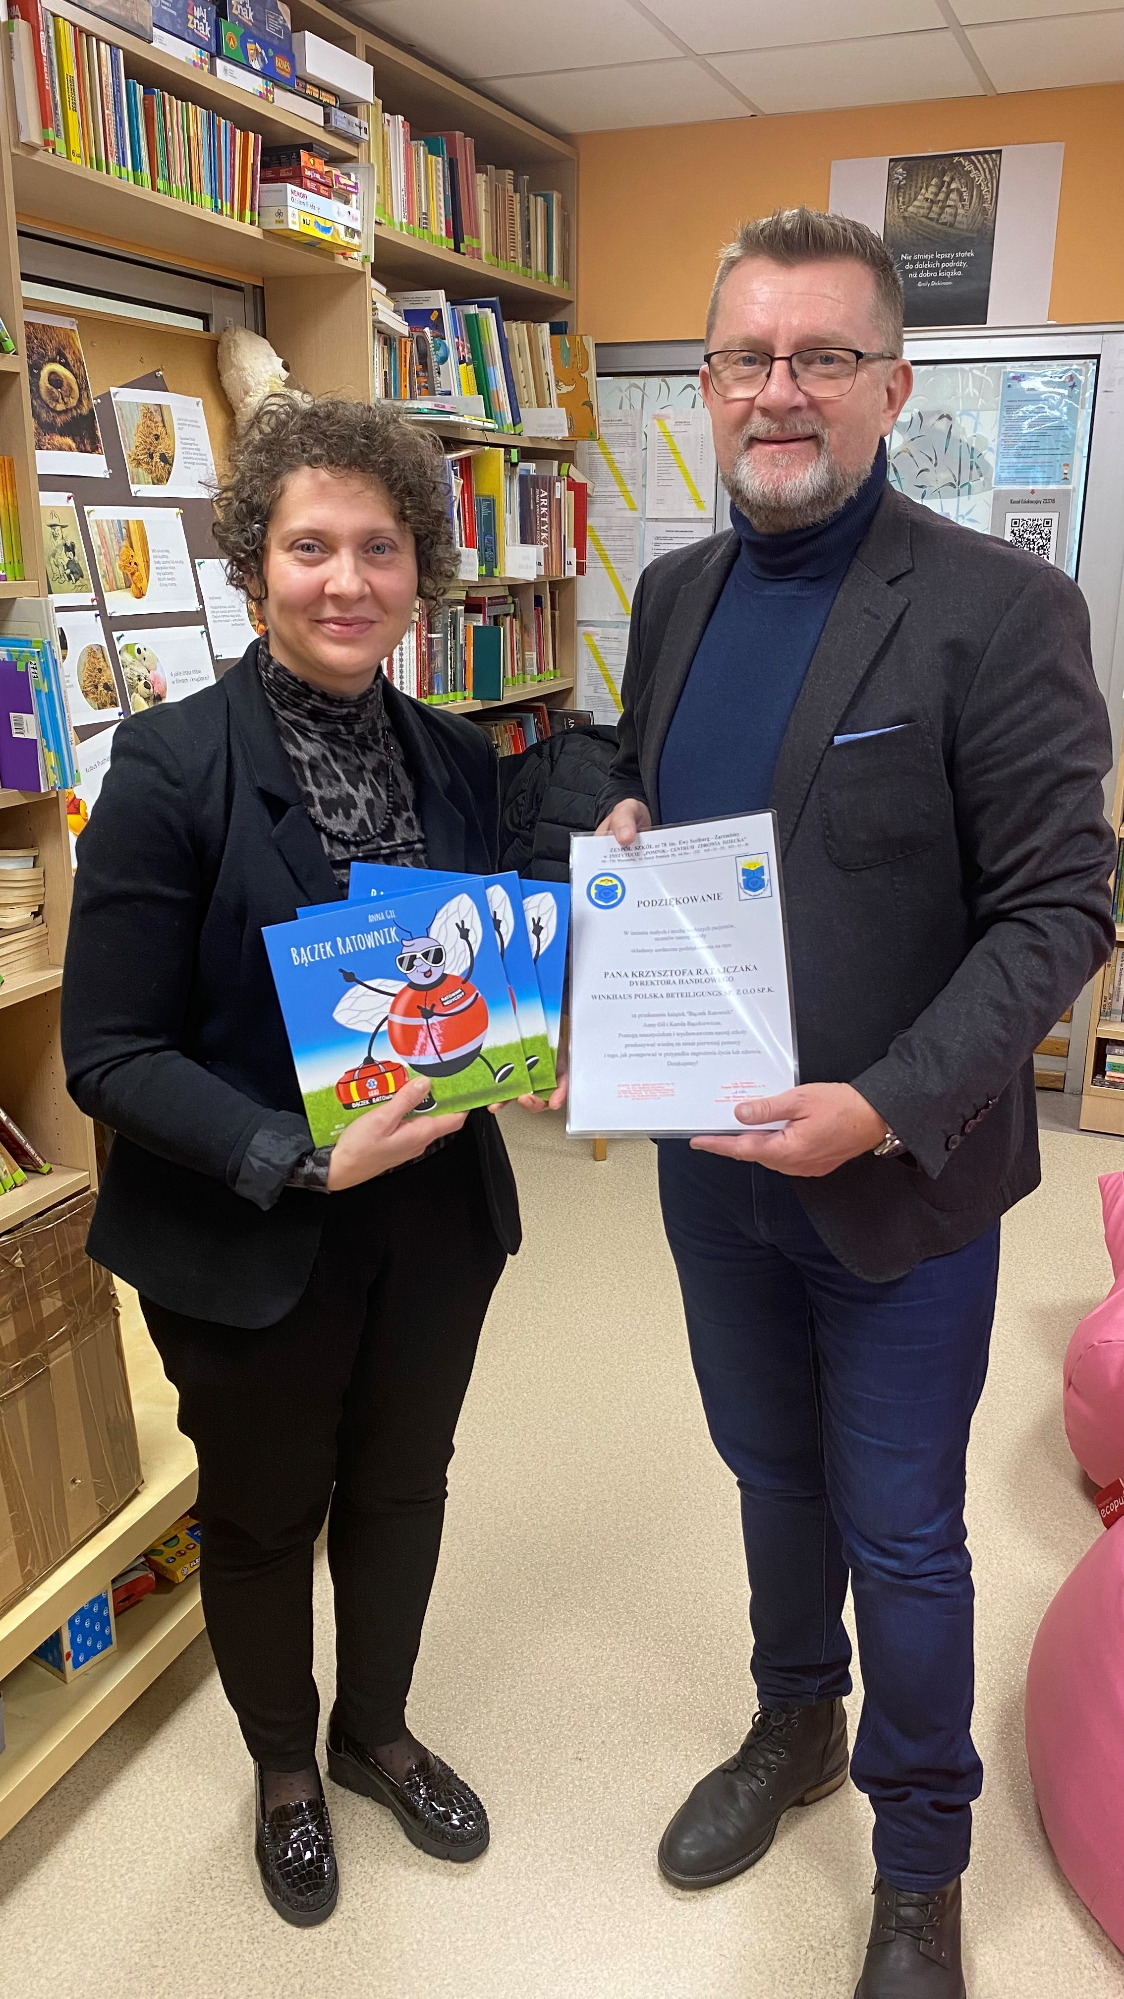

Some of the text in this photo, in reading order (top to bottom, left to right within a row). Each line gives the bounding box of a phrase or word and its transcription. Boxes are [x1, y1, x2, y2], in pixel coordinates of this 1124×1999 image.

[901, 249, 975, 261] Nie istnieje lepszy statek
[904, 259, 968, 271] do dalekich podróży,
[918, 269, 938, 278] dobra
[539, 488, 549, 549] ARKTYKA
[634, 843, 652, 852] SZKÓŁ
[637, 892, 723, 908] PODZIĘKOWANIE
[368, 909, 397, 923] ANNA GIL
[291, 926, 400, 967] BĄCZEK RATOWNIK
[603, 970, 629, 979] PANA
[631, 968, 694, 979] KRZYSZTOFA
[629, 979, 677, 987] DYREKTORA
[591, 993, 633, 1001] WINKHAUS
[634, 992, 664, 1000] POLSKA
[665, 990, 722, 999] BETEILIGUNGS
